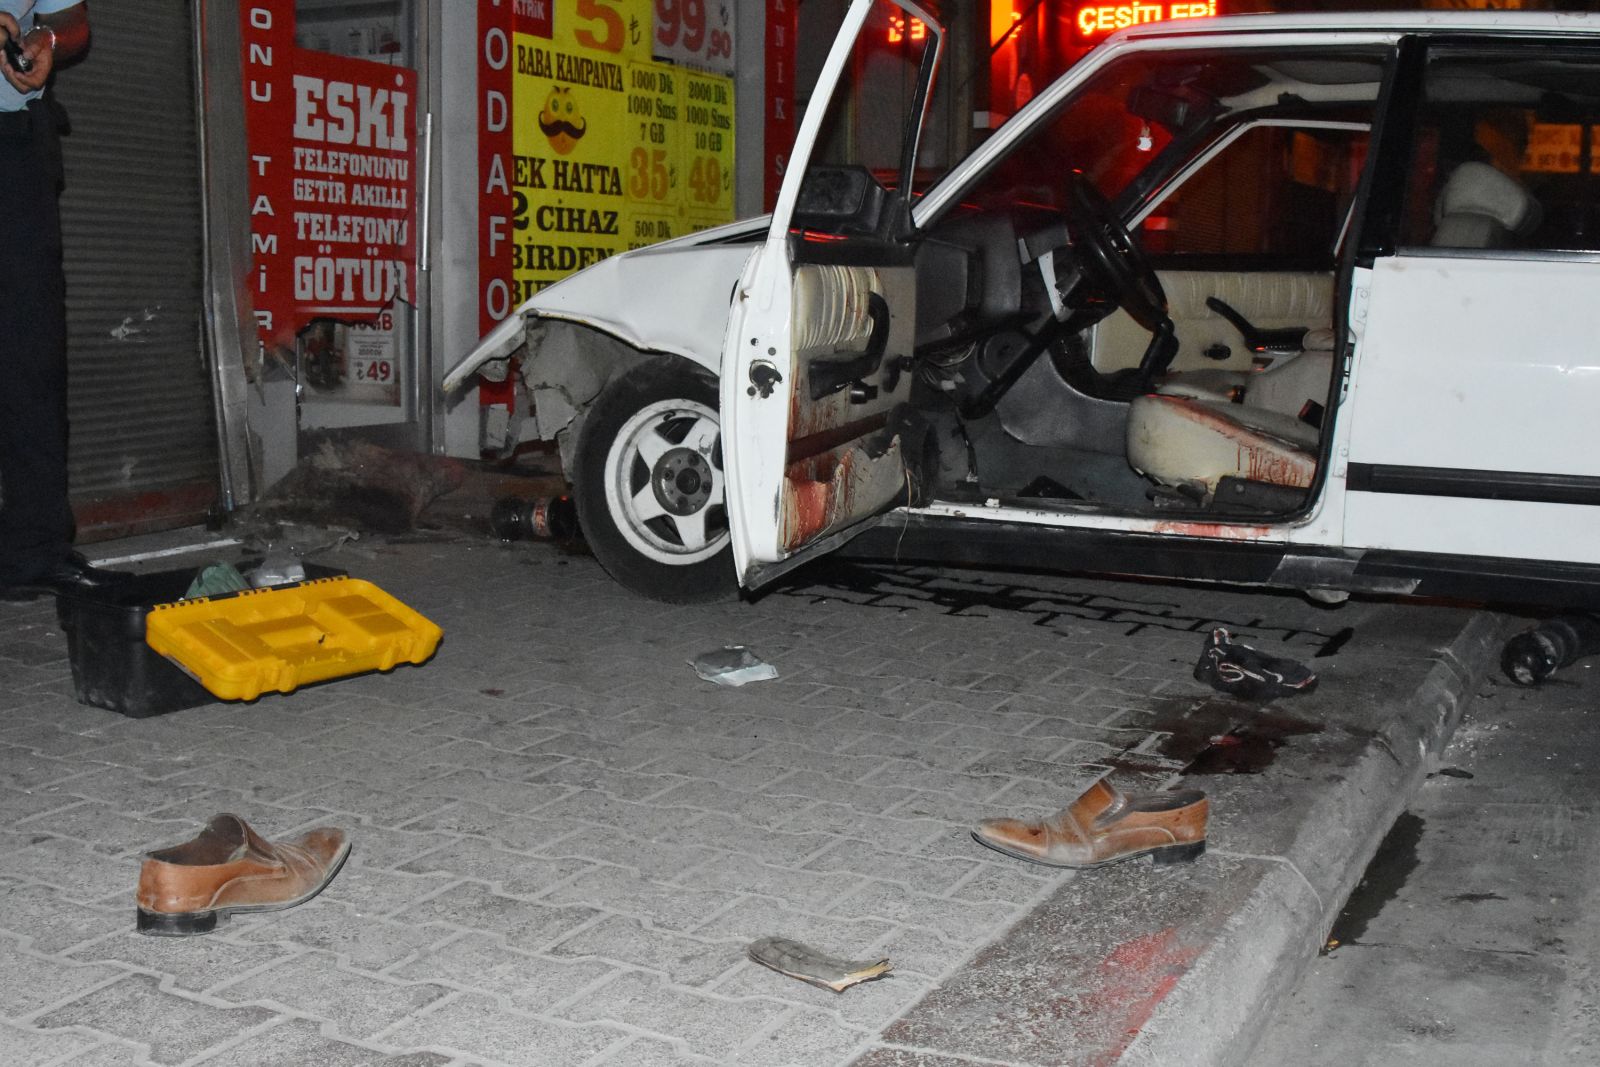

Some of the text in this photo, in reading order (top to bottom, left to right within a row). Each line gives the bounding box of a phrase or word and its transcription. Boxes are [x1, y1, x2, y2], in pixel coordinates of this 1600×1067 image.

[574, 0, 625, 54] 5
[517, 45, 624, 92] BABA KAMPANYA
[631, 70, 673, 95] 1000 Dk
[627, 95, 677, 120] 1000 Sms
[688, 81, 727, 105] 2000 Dk
[293, 74, 408, 152] ESKİ
[686, 105, 730, 130] 1000 Sms
[640, 122, 665, 144] 7 GB
[696, 132, 722, 152] 10 GB
[293, 147, 408, 181] TELEFONUNU
[553, 160, 623, 196] HATTA
[630, 147, 668, 201] 35
[689, 156, 721, 205] 49
[294, 175, 407, 209] GETİR AKILLI
[294, 212, 408, 246] TELEFONU
[513, 190, 619, 235] 2 CİHAZ
[635, 221, 671, 239] 500 Dk
[294, 244, 409, 302] GÖTÜR
[367, 361, 391, 381] 49
